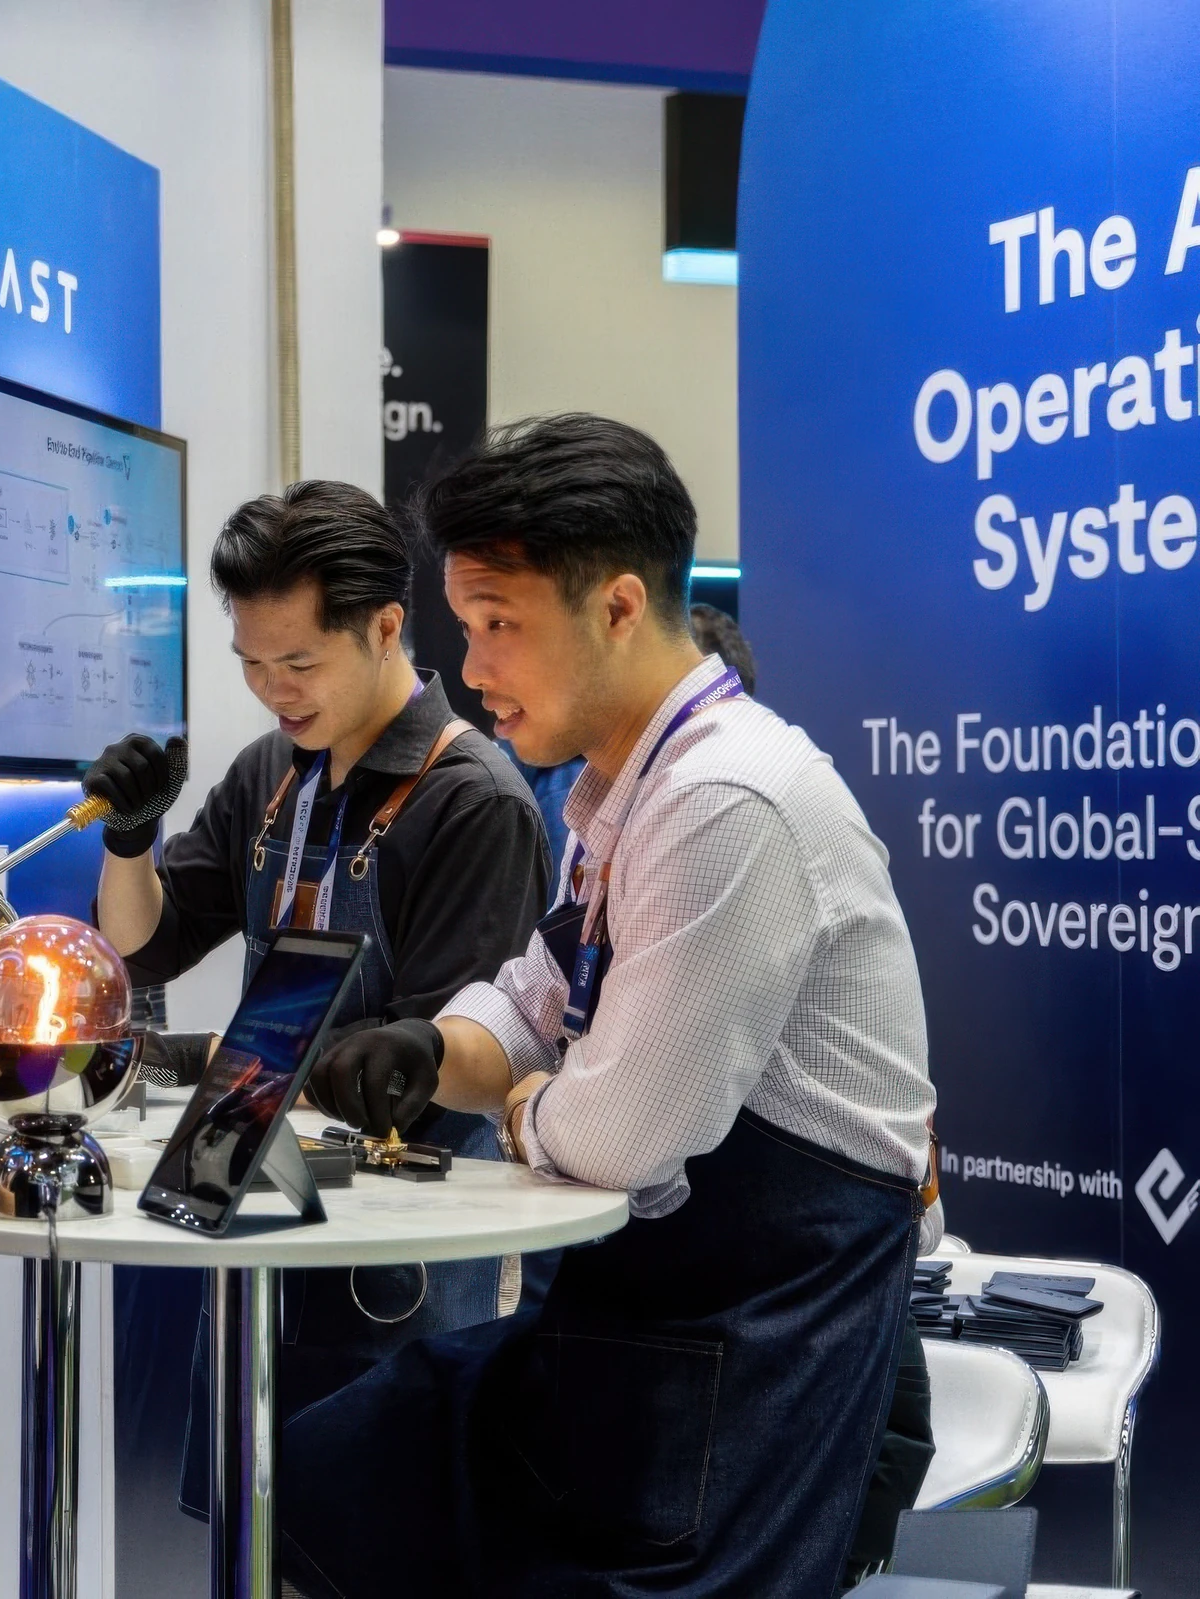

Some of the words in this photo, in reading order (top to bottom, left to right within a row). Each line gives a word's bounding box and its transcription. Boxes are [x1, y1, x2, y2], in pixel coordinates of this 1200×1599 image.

[988, 205, 1137, 313] The
[913, 318, 1200, 481] Operat
[972, 483, 1198, 613] Syste
[862, 717, 941, 776] The
[956, 703, 1200, 774] Foundatio
[918, 798, 981, 859] for
[941, 1146, 959, 1174] In
[963, 1155, 1075, 1198] partnership
[1078, 1168, 1124, 1200] with
